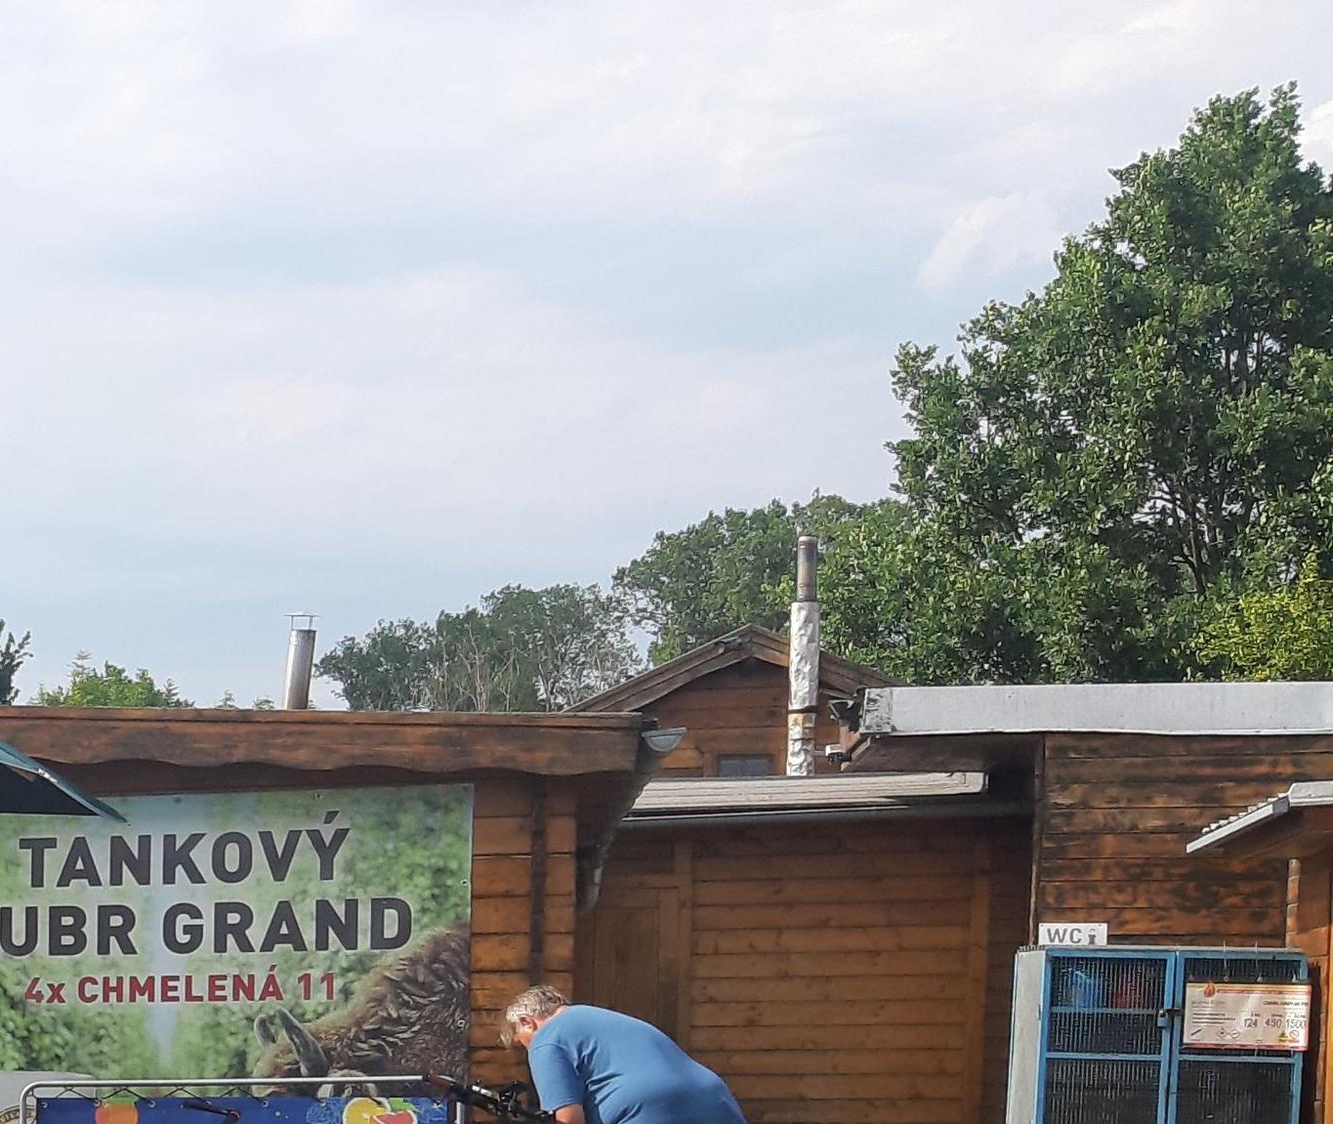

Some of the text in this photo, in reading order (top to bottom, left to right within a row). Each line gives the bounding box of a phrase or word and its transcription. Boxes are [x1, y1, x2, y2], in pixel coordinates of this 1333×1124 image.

[18, 810, 351, 889] TANKOVÝ
[162, 897, 413, 955] GRAND
[1046, 927, 1083, 944] WC
[24, 964, 335, 1004] 4x CHMELENÁ 11
